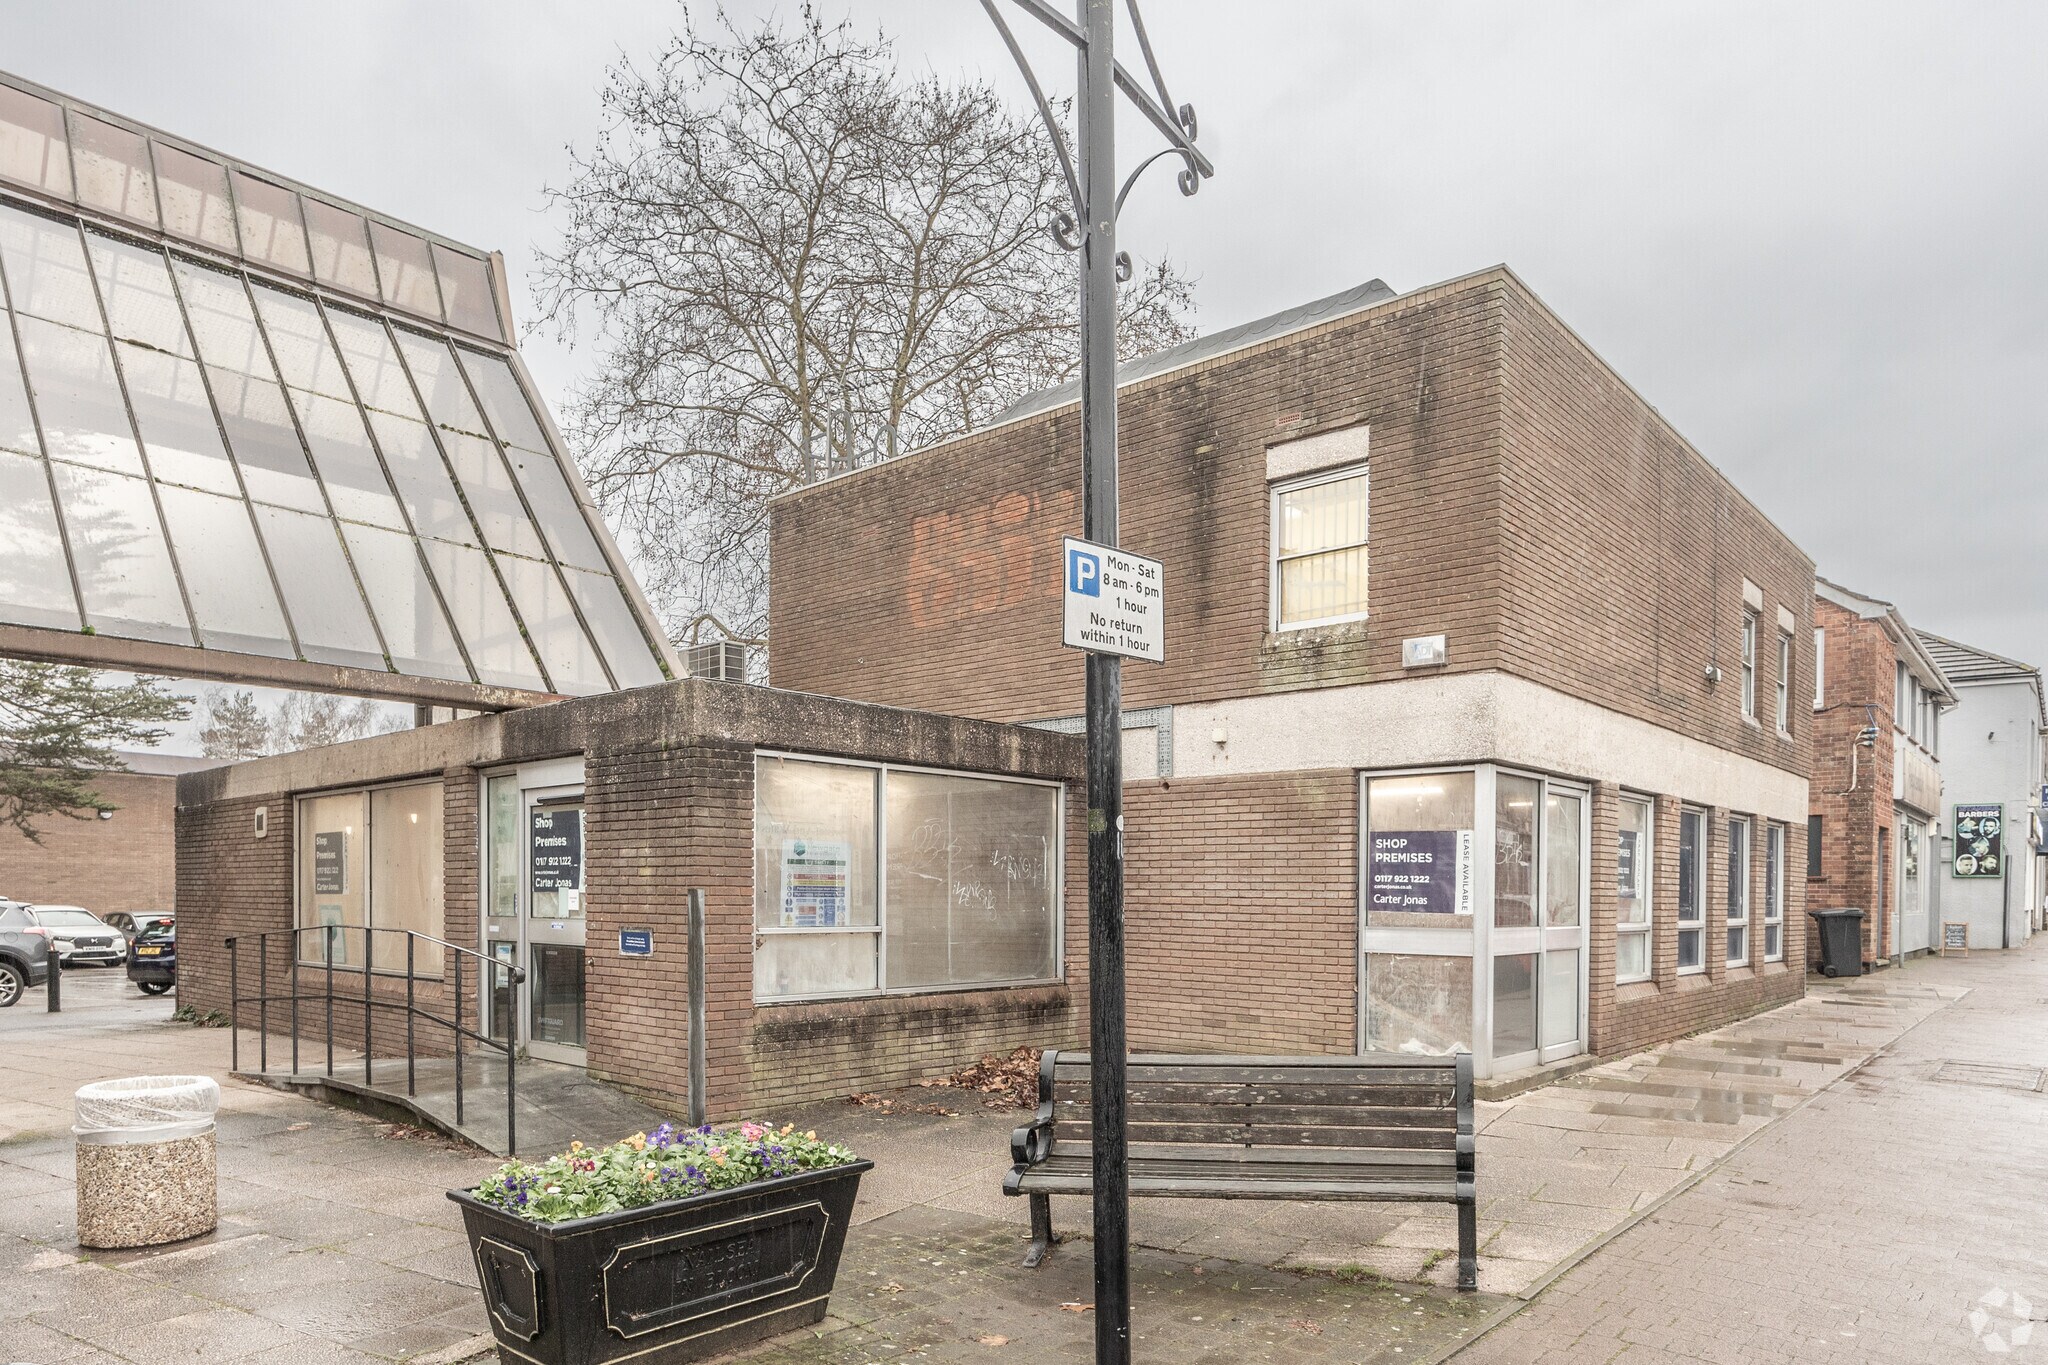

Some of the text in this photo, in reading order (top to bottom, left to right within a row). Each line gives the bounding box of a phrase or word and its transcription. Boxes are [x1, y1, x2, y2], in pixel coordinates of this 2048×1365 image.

[1077, 556, 1096, 589] P
[1107, 555, 1130, 573] Mon
[1138, 564, 1155, 579] Sat
[1117, 597, 1147, 615] 1 hour
[1090, 612, 1143, 634] No return
[1081, 629, 1150, 652] within 1 hour
[535, 817, 553, 829] Shop
[535, 836, 567, 847] Premises
[1375, 838, 1408, 849] SHOP
[1375, 853, 1433, 863] PREMISES
[535, 878, 572, 888] Carter Jonas
[1394, 875, 1409, 883] 922
[1410, 875, 1430, 883] 1222
[1461, 864, 1469, 911] AVAILABLE
[1374, 893, 1428, 906] Carter Jonas
